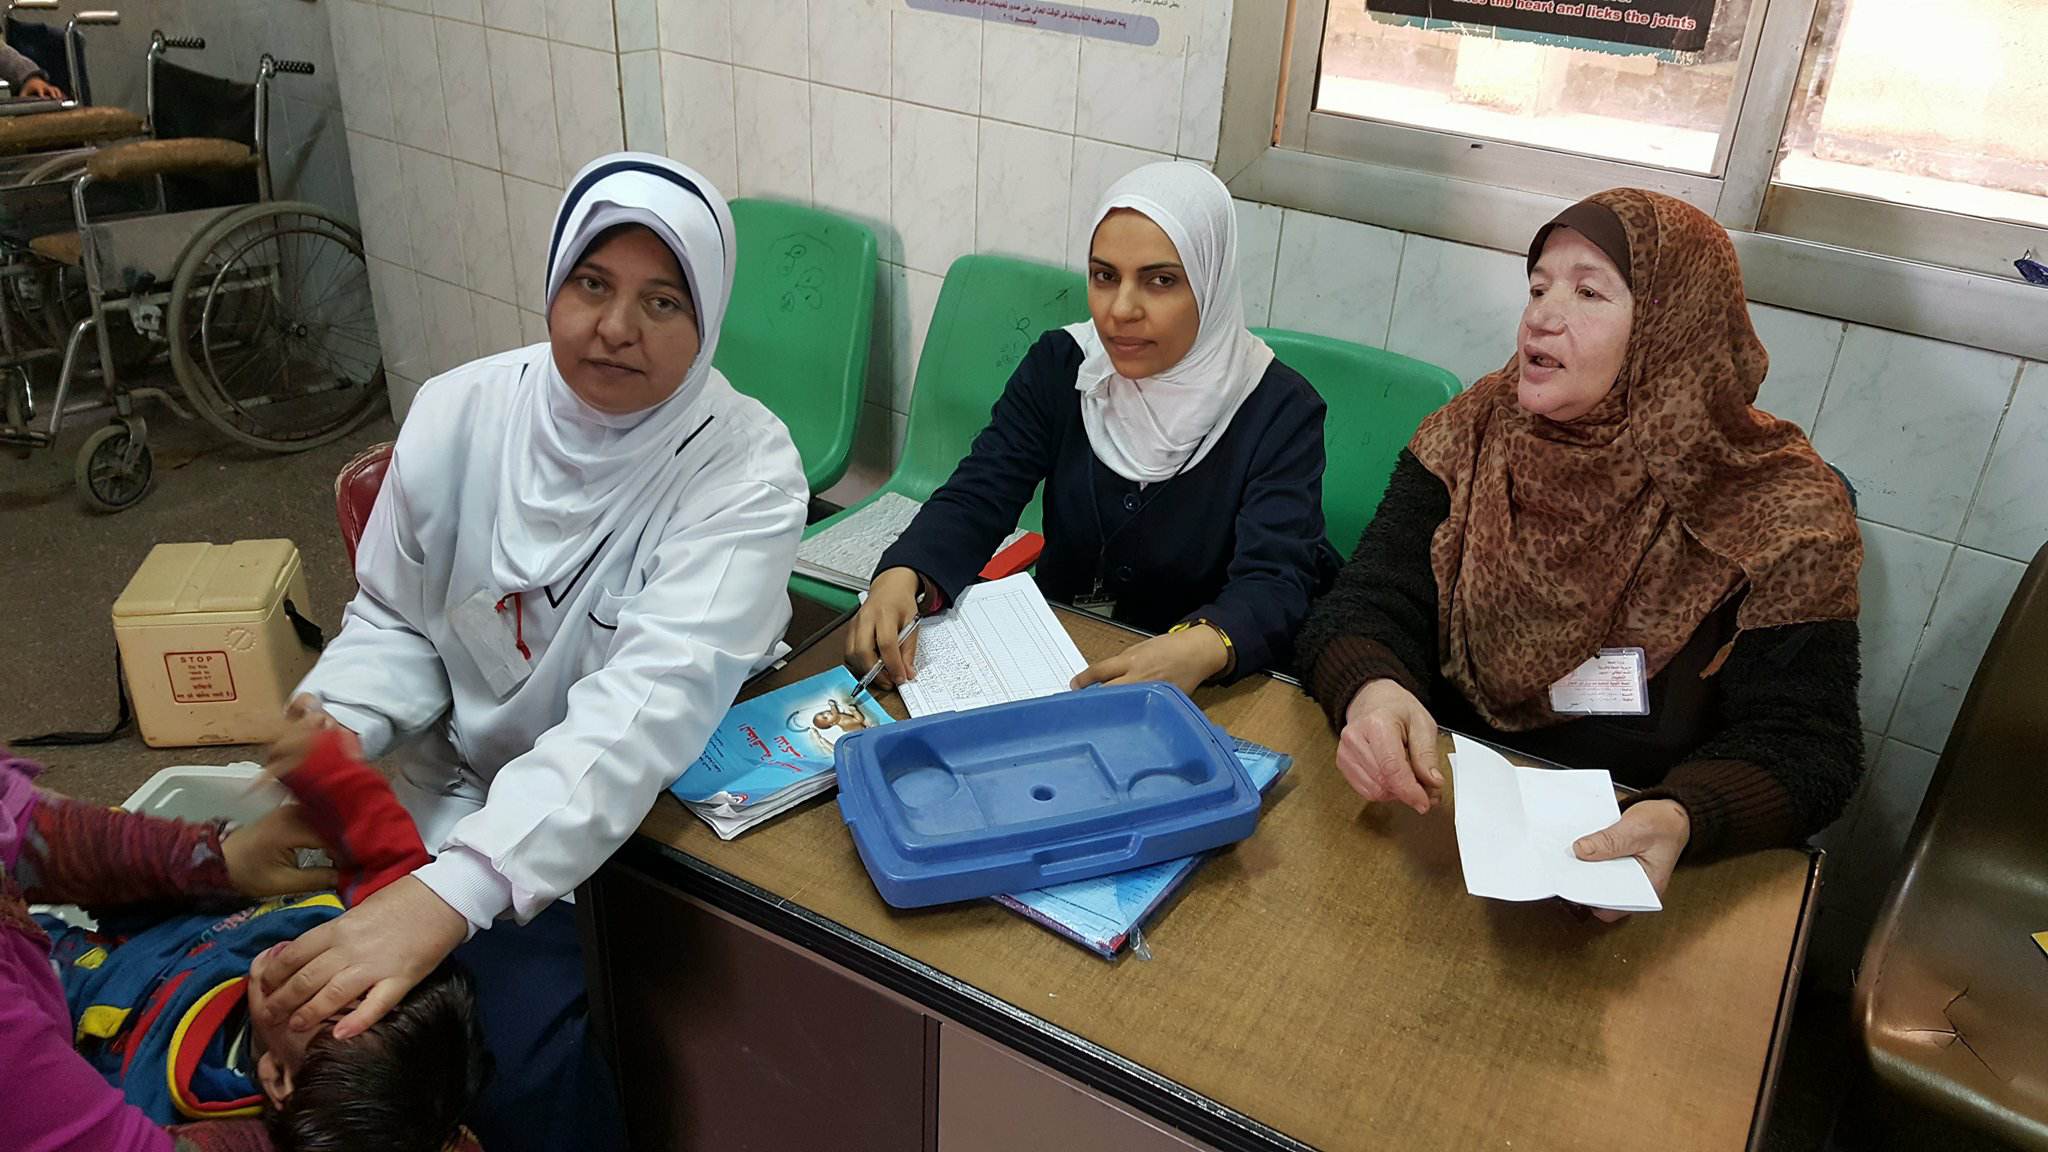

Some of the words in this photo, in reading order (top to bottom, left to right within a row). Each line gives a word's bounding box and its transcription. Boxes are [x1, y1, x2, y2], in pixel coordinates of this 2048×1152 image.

[1515, 0, 1555, 13] heart
[1555, 3, 1585, 16] and
[1586, 4, 1622, 22] licks
[1624, 9, 1650, 25] the
[1650, 11, 1697, 30] joints
[180, 655, 213, 664] STOP
